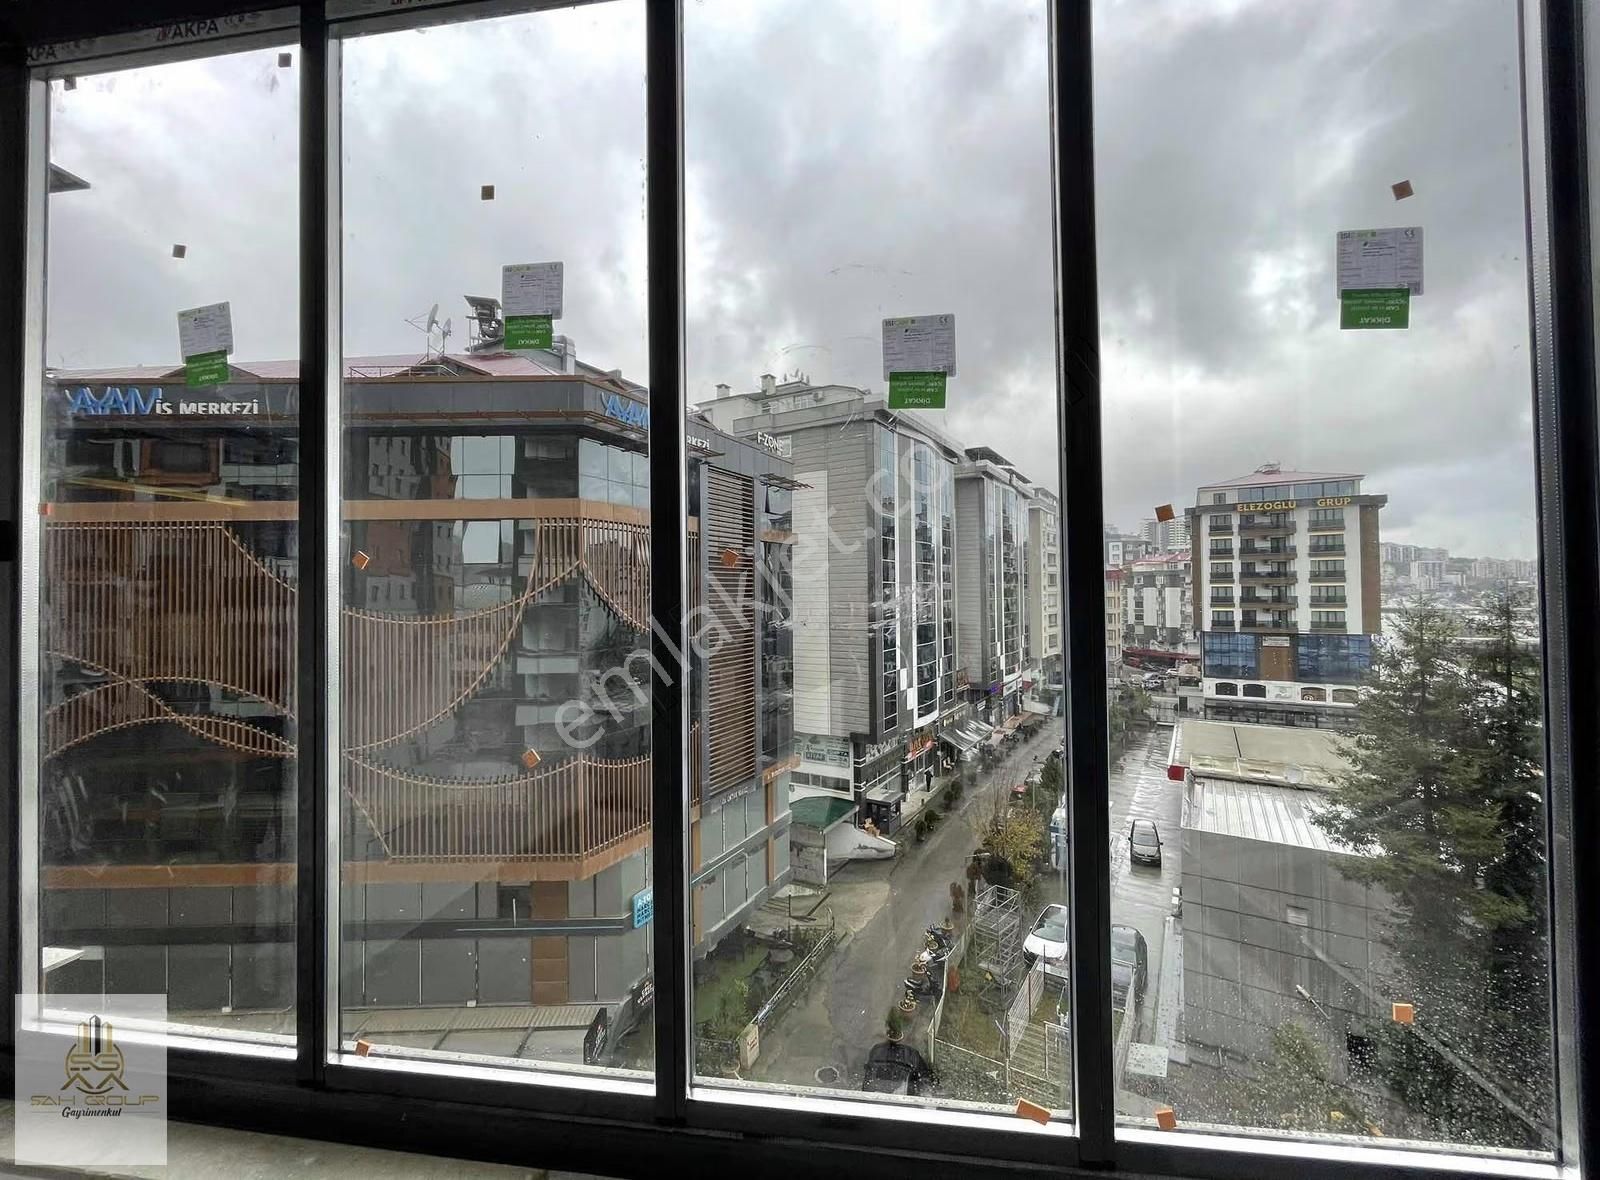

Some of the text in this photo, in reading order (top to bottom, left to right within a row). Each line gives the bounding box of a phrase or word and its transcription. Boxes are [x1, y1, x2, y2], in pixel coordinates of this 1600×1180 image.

[171, 19, 220, 40] AKPA
[179, 399, 260, 415] MERKEZİ
[1316, 497, 1352, 507] GRUP
